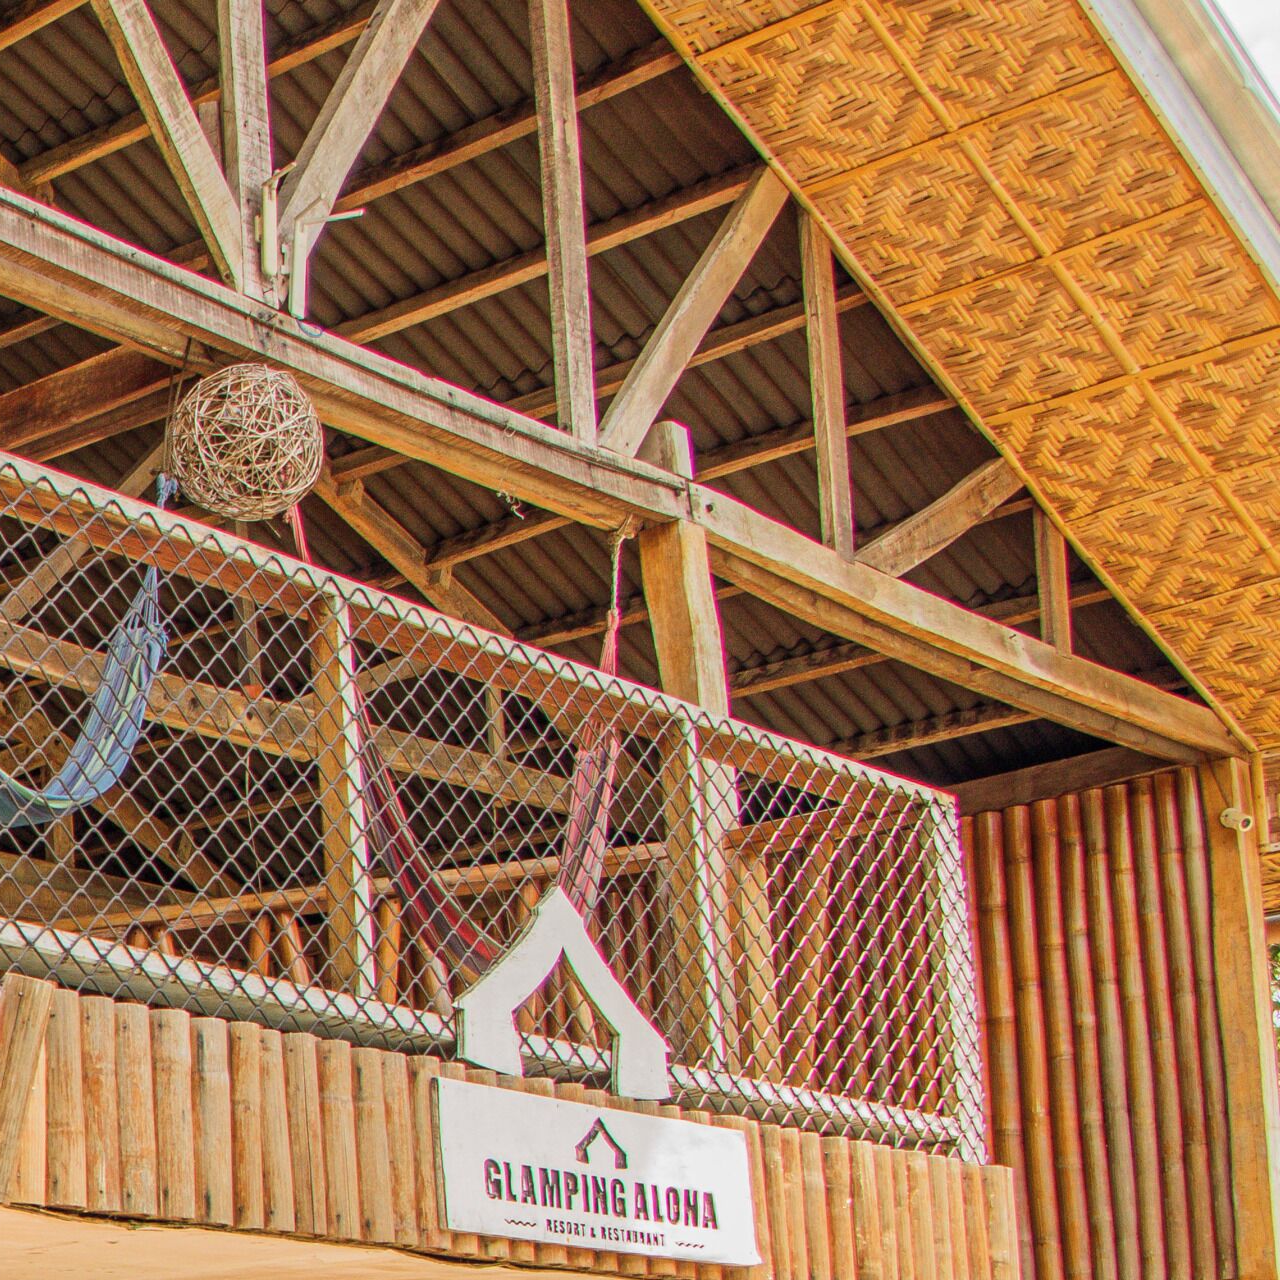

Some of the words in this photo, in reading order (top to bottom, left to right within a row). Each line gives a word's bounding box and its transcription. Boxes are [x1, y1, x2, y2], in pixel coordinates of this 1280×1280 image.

[483, 1158, 628, 1218] GLAMPING
[634, 1182, 718, 1231] ALONA
[545, 1218, 587, 1238] RESORT
[590, 1226, 597, 1239] &
[600, 1226, 666, 1247] RESTAURANT
